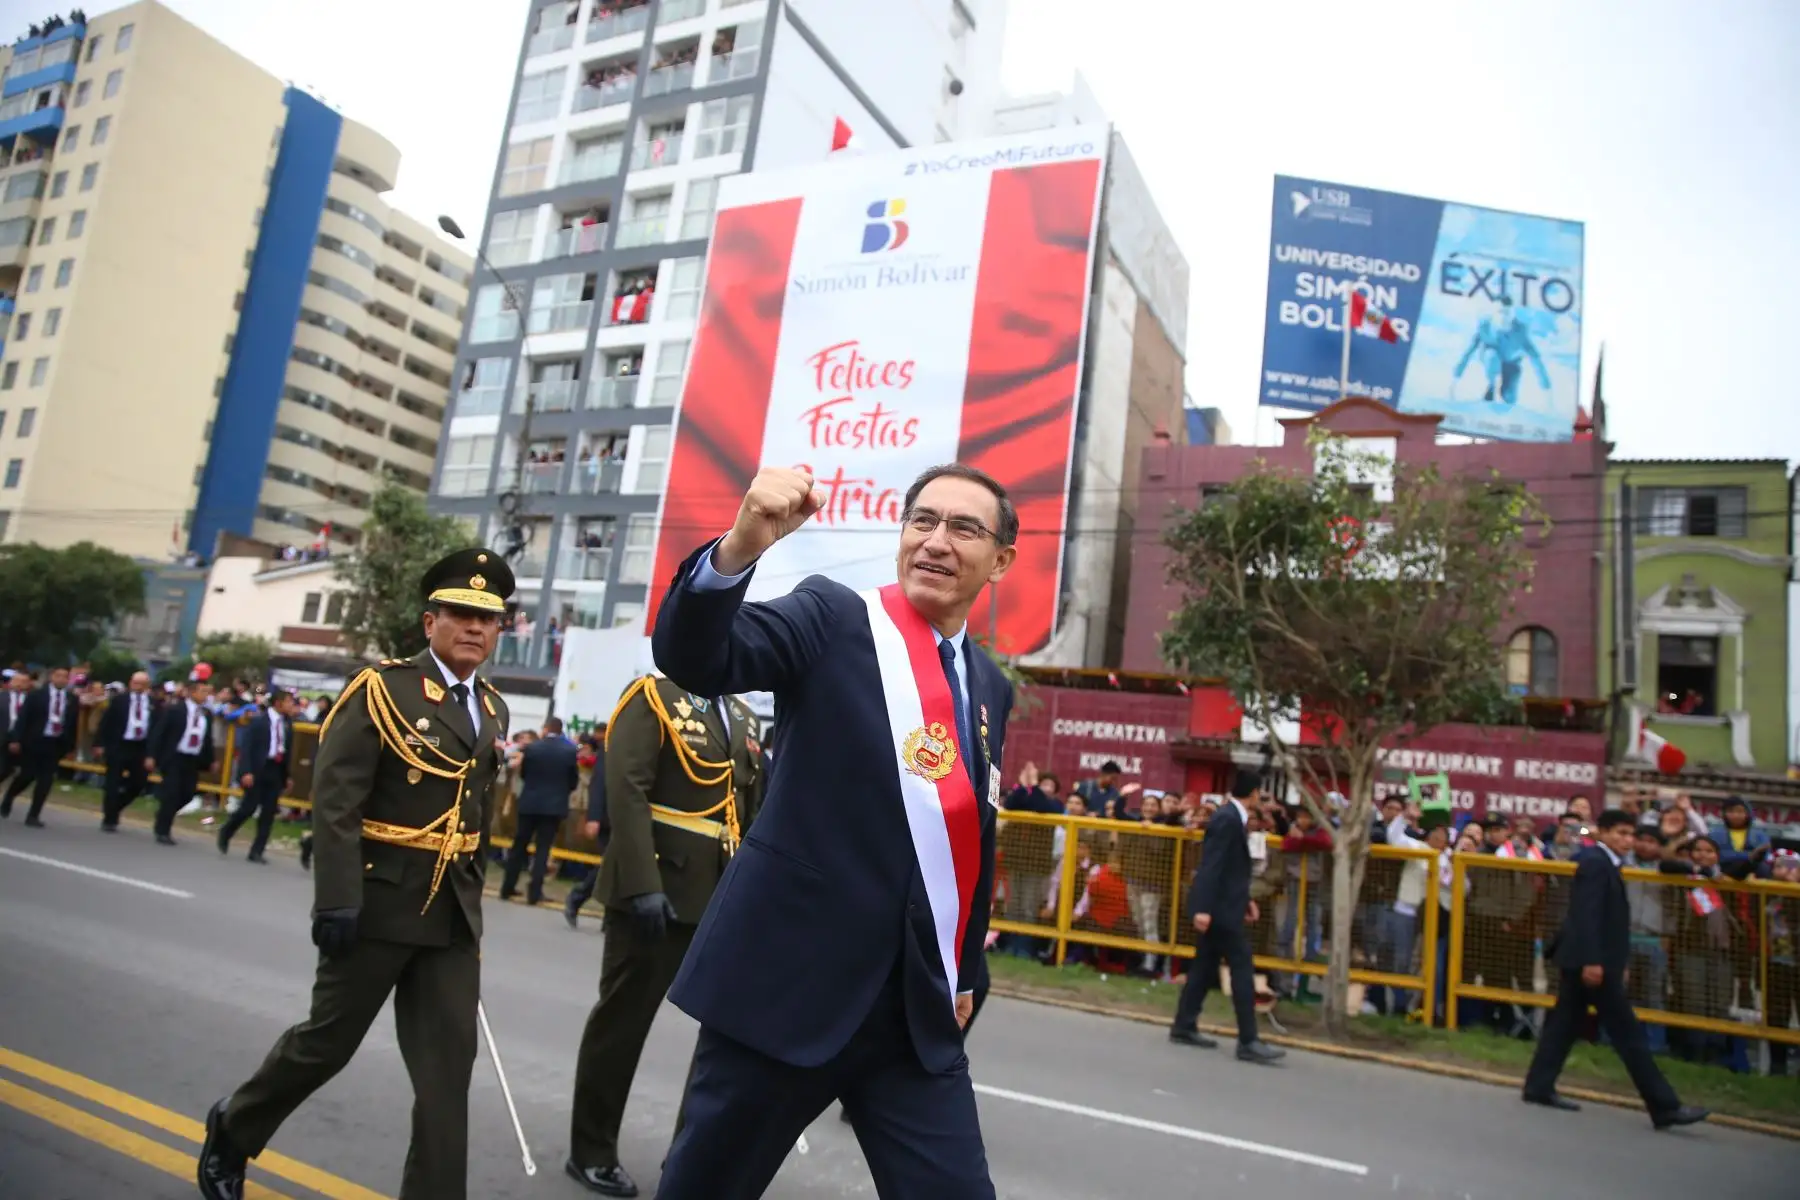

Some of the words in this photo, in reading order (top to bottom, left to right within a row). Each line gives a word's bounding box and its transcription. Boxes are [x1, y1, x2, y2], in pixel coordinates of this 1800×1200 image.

[904, 142, 1095, 177] #YoCreoMiFuturo
[1312, 187, 1350, 208] USB
[1275, 243, 1421, 282] UNIVERSIDAD
[792, 268, 867, 297] Simón
[1295, 272, 1398, 310] SIMÓN
[1440, 251, 1574, 314] ÉXITO
[1279, 300, 1410, 342] BOLR
[806, 341, 914, 392] Felices
[798, 395, 919, 450] Fiestas
[1053, 719, 1166, 742] COOPERATIVA
[1514, 760, 1597, 785] RECREO
